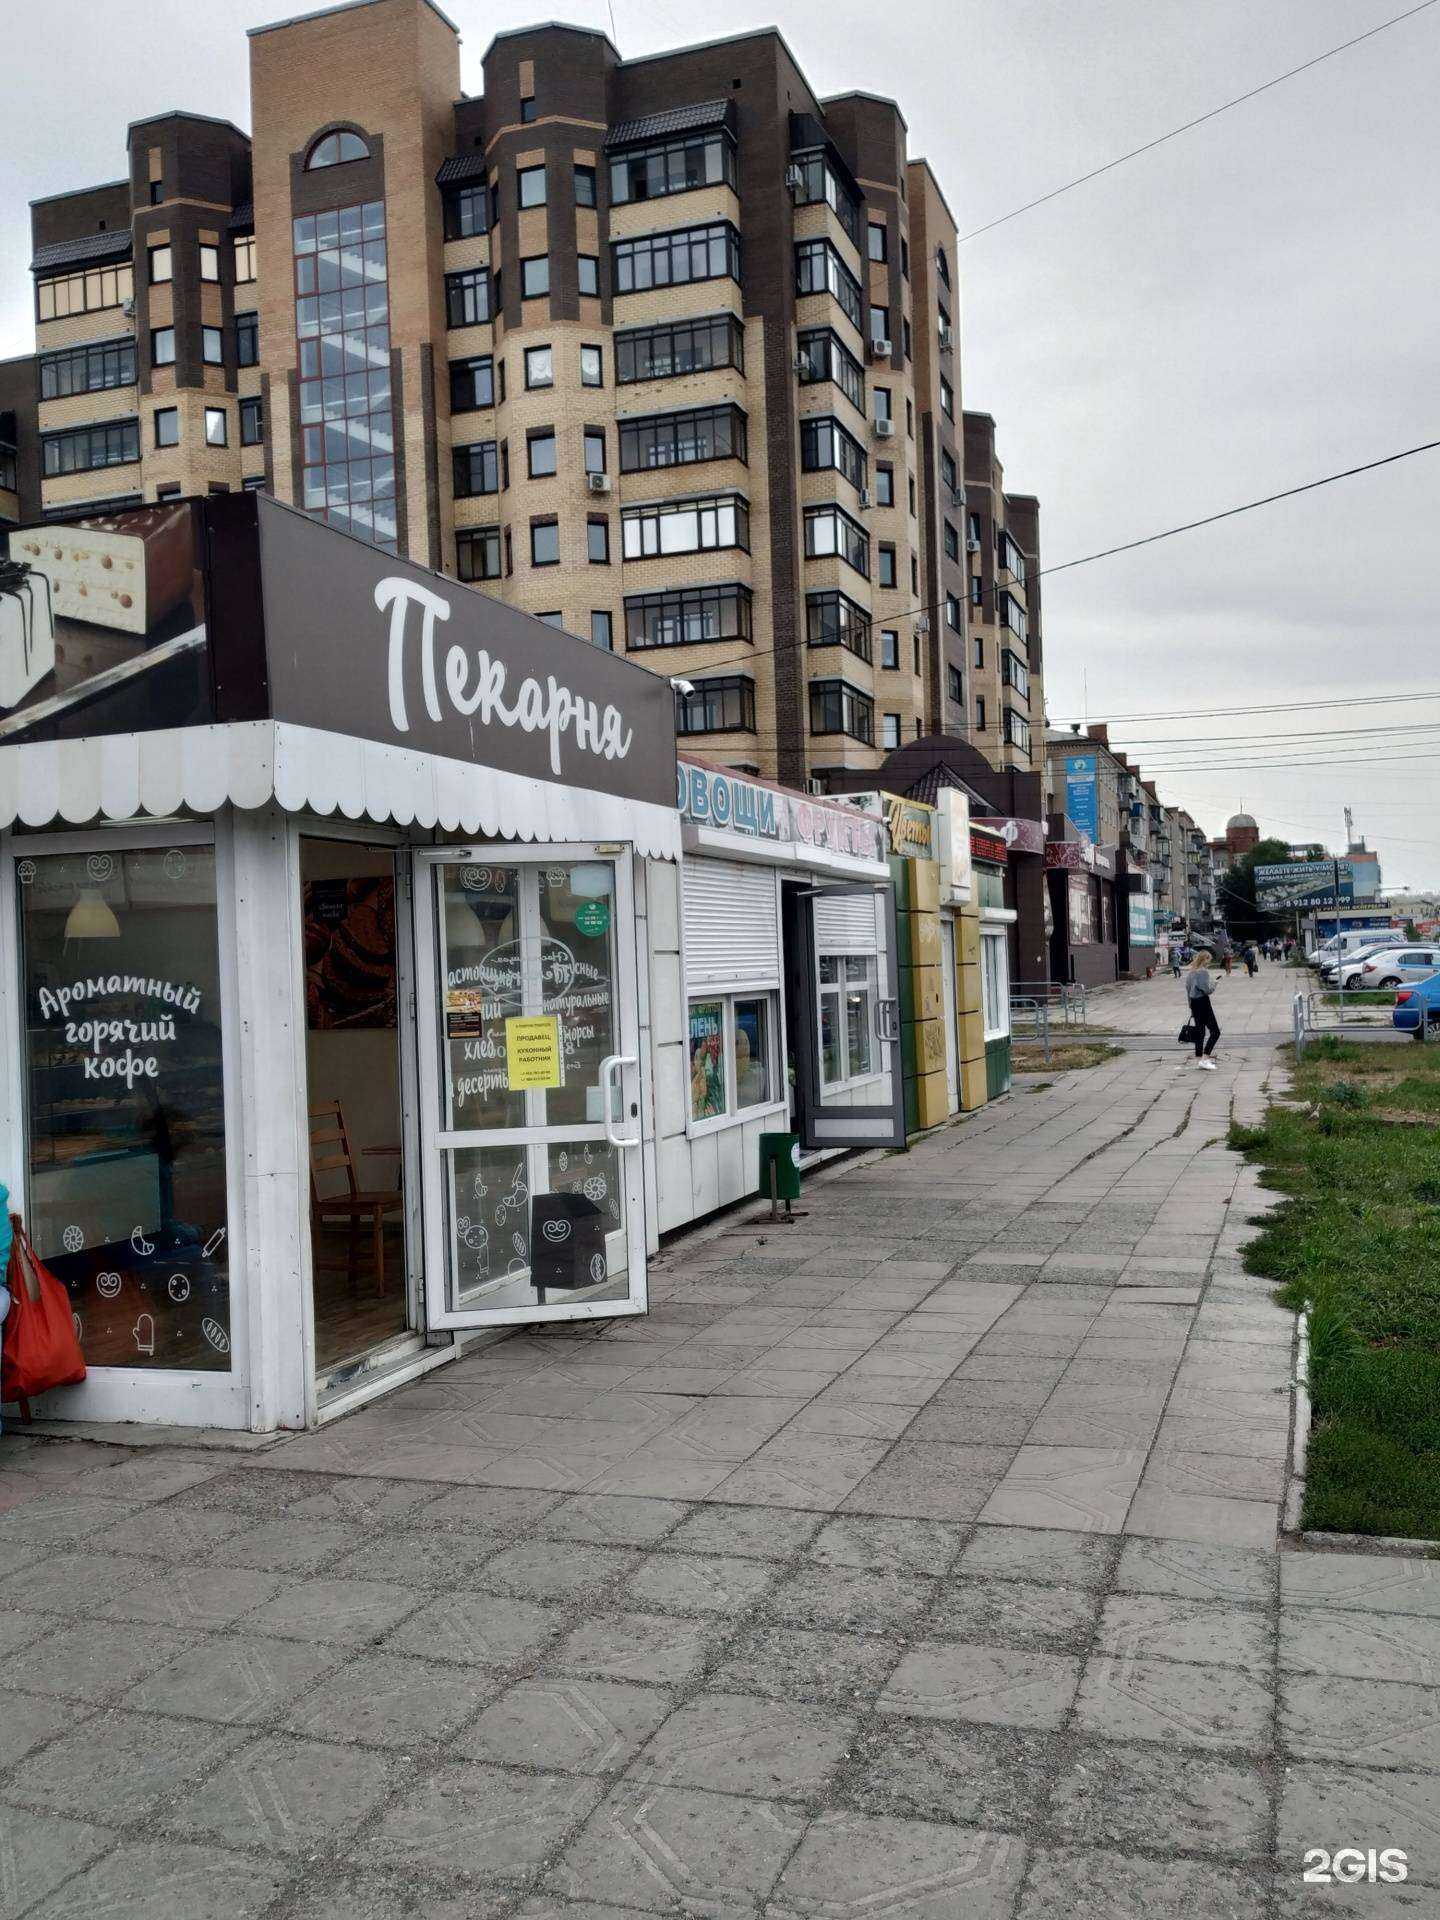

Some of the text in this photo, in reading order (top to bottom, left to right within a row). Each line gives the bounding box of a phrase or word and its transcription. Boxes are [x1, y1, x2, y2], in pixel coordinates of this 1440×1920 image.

[374, 576, 633, 775] Пекарня
[1321, 863, 1350, 871] МОЯ?
[1293, 899, 1309, 907] 912
[1310, 898, 1321, 906] 80
[1323, 897, 1334, 905] 12
[448, 965, 513, 991] астоящий
[38, 975, 202, 1019] Ароматный
[544, 991, 609, 1016] натуральные
[64, 1014, 176, 1054] горячий
[689, 1016, 719, 1039] ЛЕНЬ
[464, 1028, 496, 1061] хлеб
[84, 1049, 159, 1090] кофе
